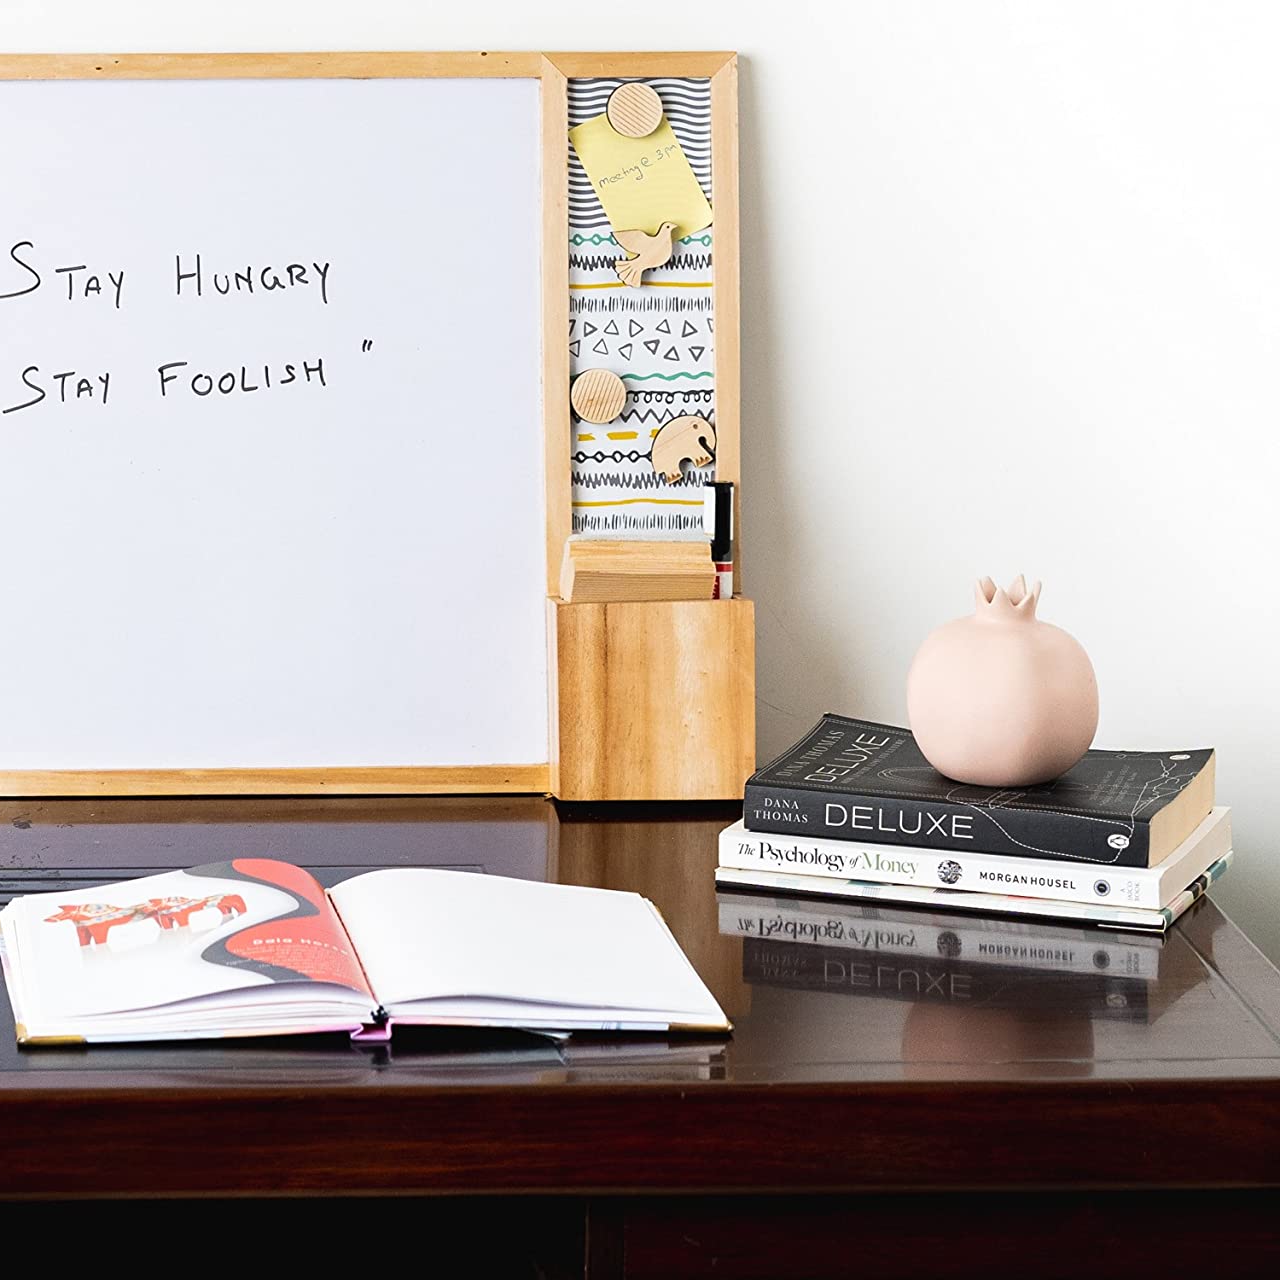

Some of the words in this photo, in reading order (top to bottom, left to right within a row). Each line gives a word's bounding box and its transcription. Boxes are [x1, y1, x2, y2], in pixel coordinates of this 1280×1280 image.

[598, 165, 644, 188] meeting
[2, 366, 110, 415] STAY
[158, 359, 326, 396] FOOLISH
[776, 760, 811, 777] DANA
[799, 729, 845, 760] THOMAS
[804, 733, 891, 783] DELUXE
[754, 809, 809, 824] THOMAS
[764, 797, 799, 810] DANA
[825, 803, 974, 839] DELUXE
[738, 842, 756, 856] The
[759, 841, 848, 872] Psychology
[849, 854, 862, 868] of
[861, 852, 919, 879] Money
[979, 871, 1028, 884] MORGAN
[1030, 876, 1076, 890] HOUSEL
[253, 937, 293, 946] Dala
